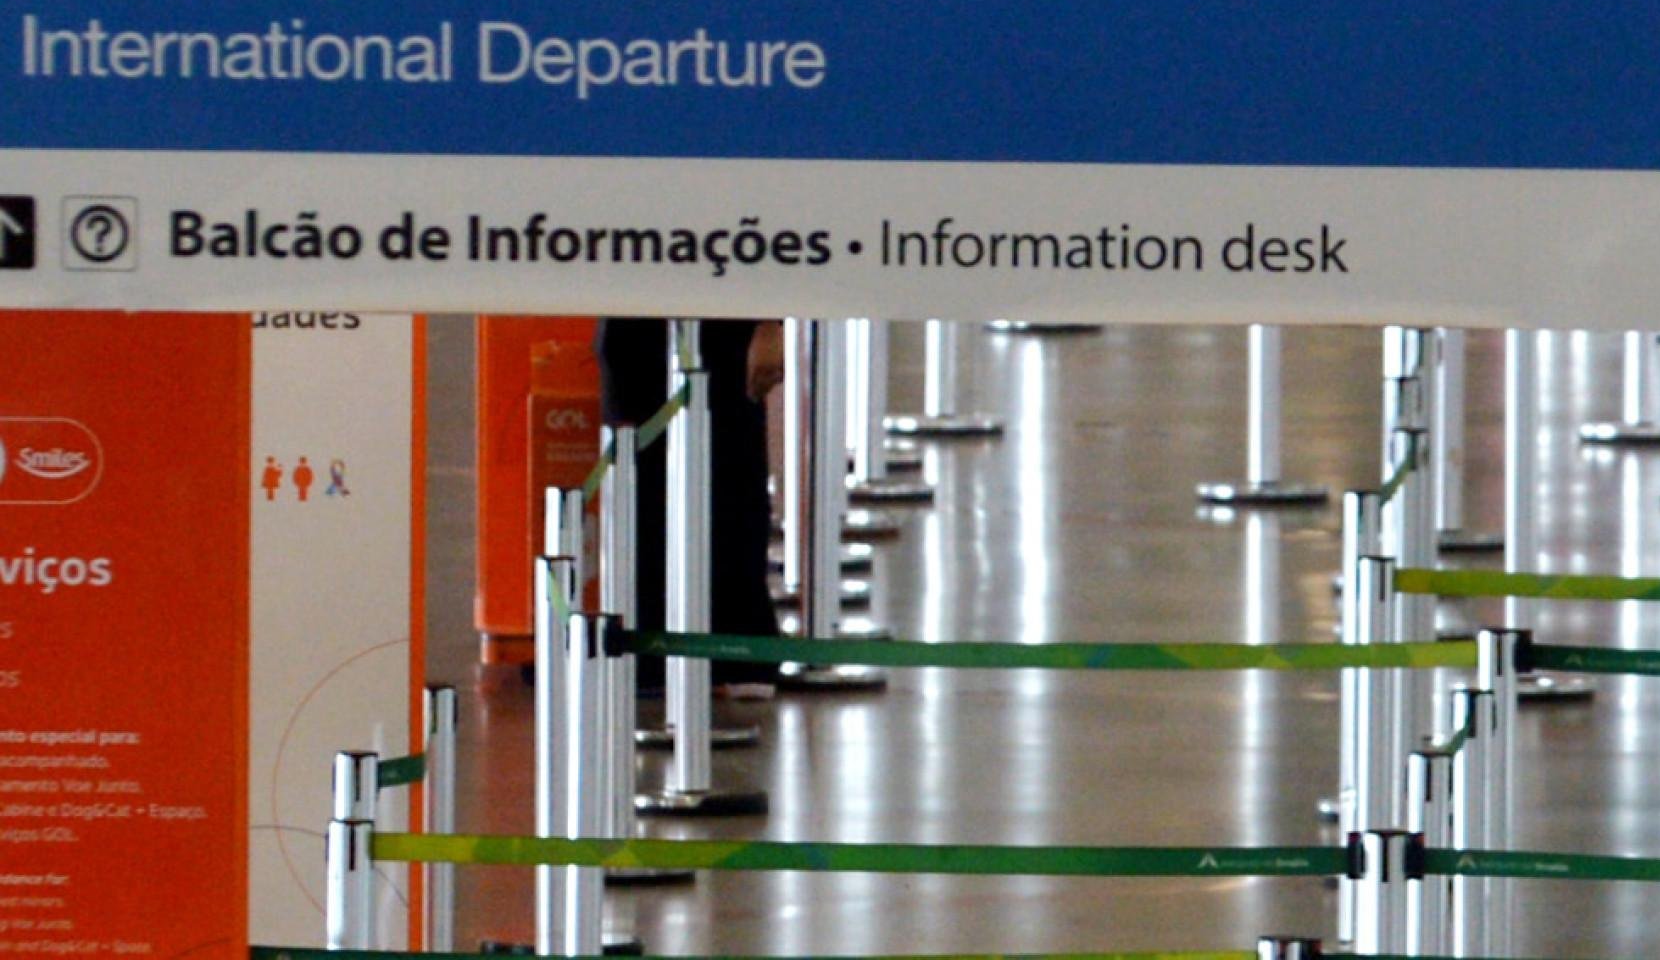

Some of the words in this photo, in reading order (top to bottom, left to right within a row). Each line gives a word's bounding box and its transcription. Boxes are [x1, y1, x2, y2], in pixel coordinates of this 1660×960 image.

[23, 14, 452, 82] International
[479, 21, 826, 100] Departure
[169, 210, 362, 259] Balcão
[378, 212, 451, 261] de
[467, 212, 832, 277] Informações
[881, 218, 1204, 272] Information
[1221, 223, 1349, 273] desk
